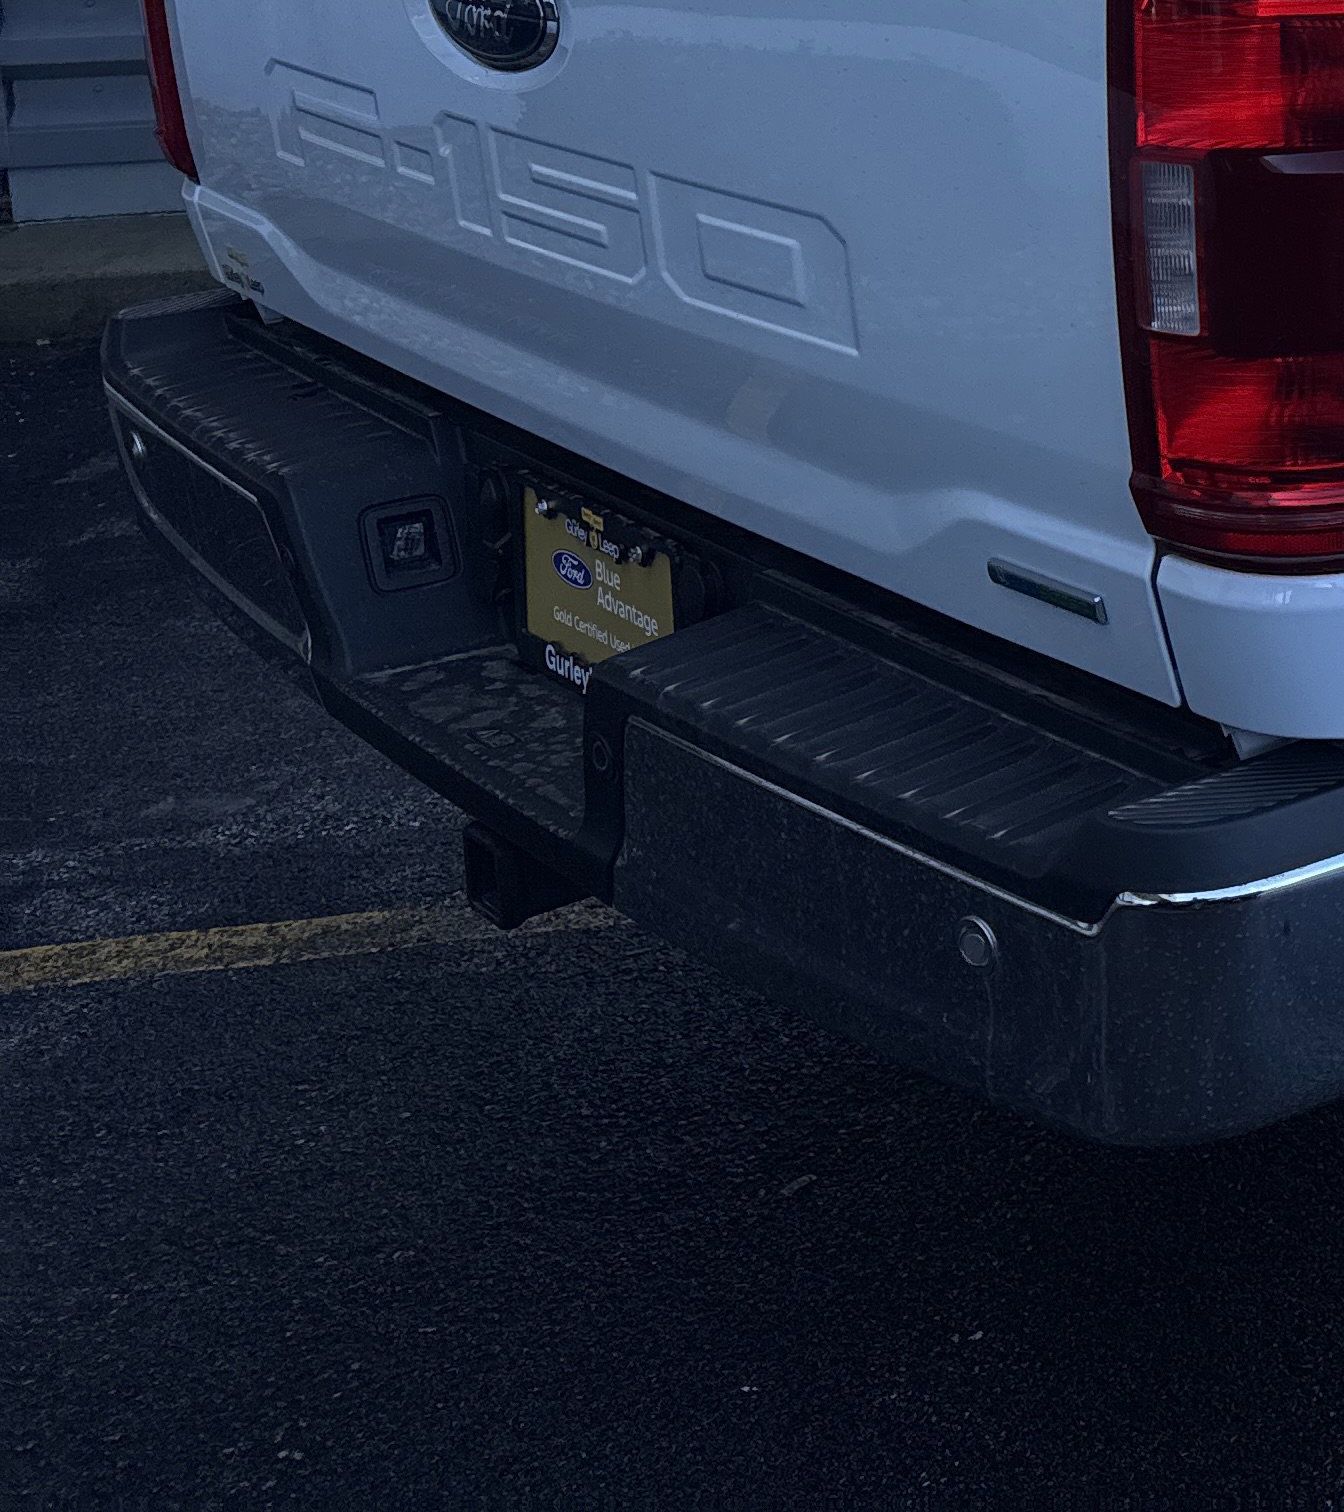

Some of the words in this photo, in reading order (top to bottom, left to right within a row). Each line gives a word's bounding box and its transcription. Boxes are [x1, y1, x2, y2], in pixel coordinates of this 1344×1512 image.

[265, 57, 860, 358] F-150
[559, 553, 586, 585] Ford
[595, 559, 621, 591] Blue
[553, 605, 572, 627] Gold
[574, 615, 608, 644] Certified
[597, 587, 659, 637] Advantage
